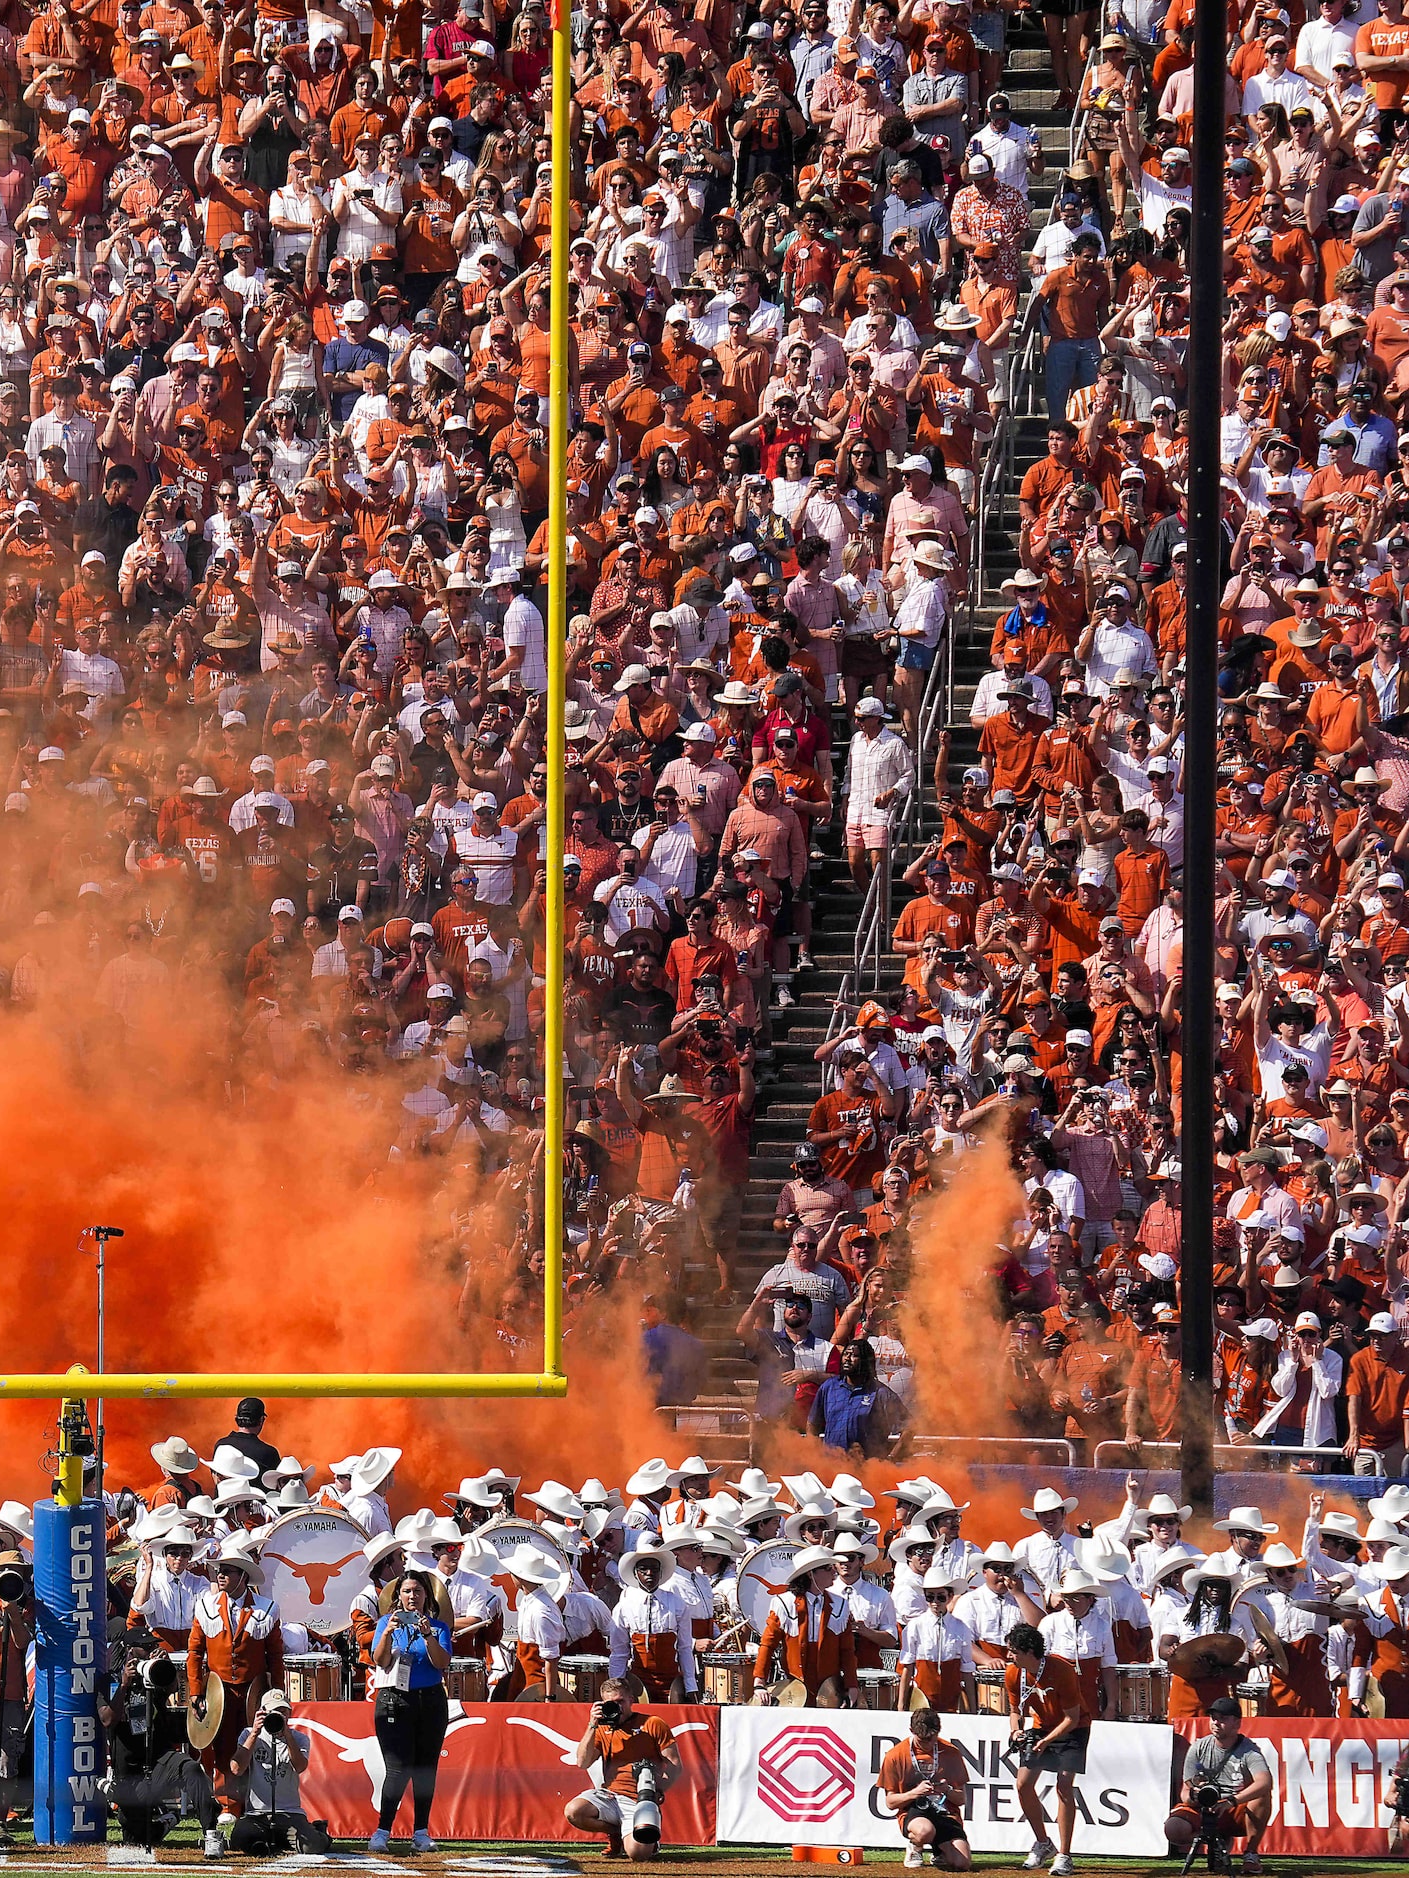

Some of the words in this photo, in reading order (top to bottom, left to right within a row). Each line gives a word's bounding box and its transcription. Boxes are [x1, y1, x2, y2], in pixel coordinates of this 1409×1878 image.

[1125, 420, 1135, 429] T
[177, 464, 209, 482] TEXAS
[1271, 481, 1280, 490] T
[598, 649, 606, 658] T
[434, 818, 468, 828] TEXAS
[611, 818, 650, 830] TEXAS
[184, 837, 219, 849] TEXAS
[947, 881, 975, 895] XAS
[451, 923, 488, 938] TEXAS
[583, 955, 615, 978] TEXAS
[601, 1128, 636, 1143] TEXAS
[303, 1521, 337, 1531] YAMAHA
[498, 1535, 532, 1545] YAMAHA
[70, 1524, 94, 1695] COTTON
[871, 1735, 1019, 1779] NK
[68, 1716, 95, 1833] BOWL
